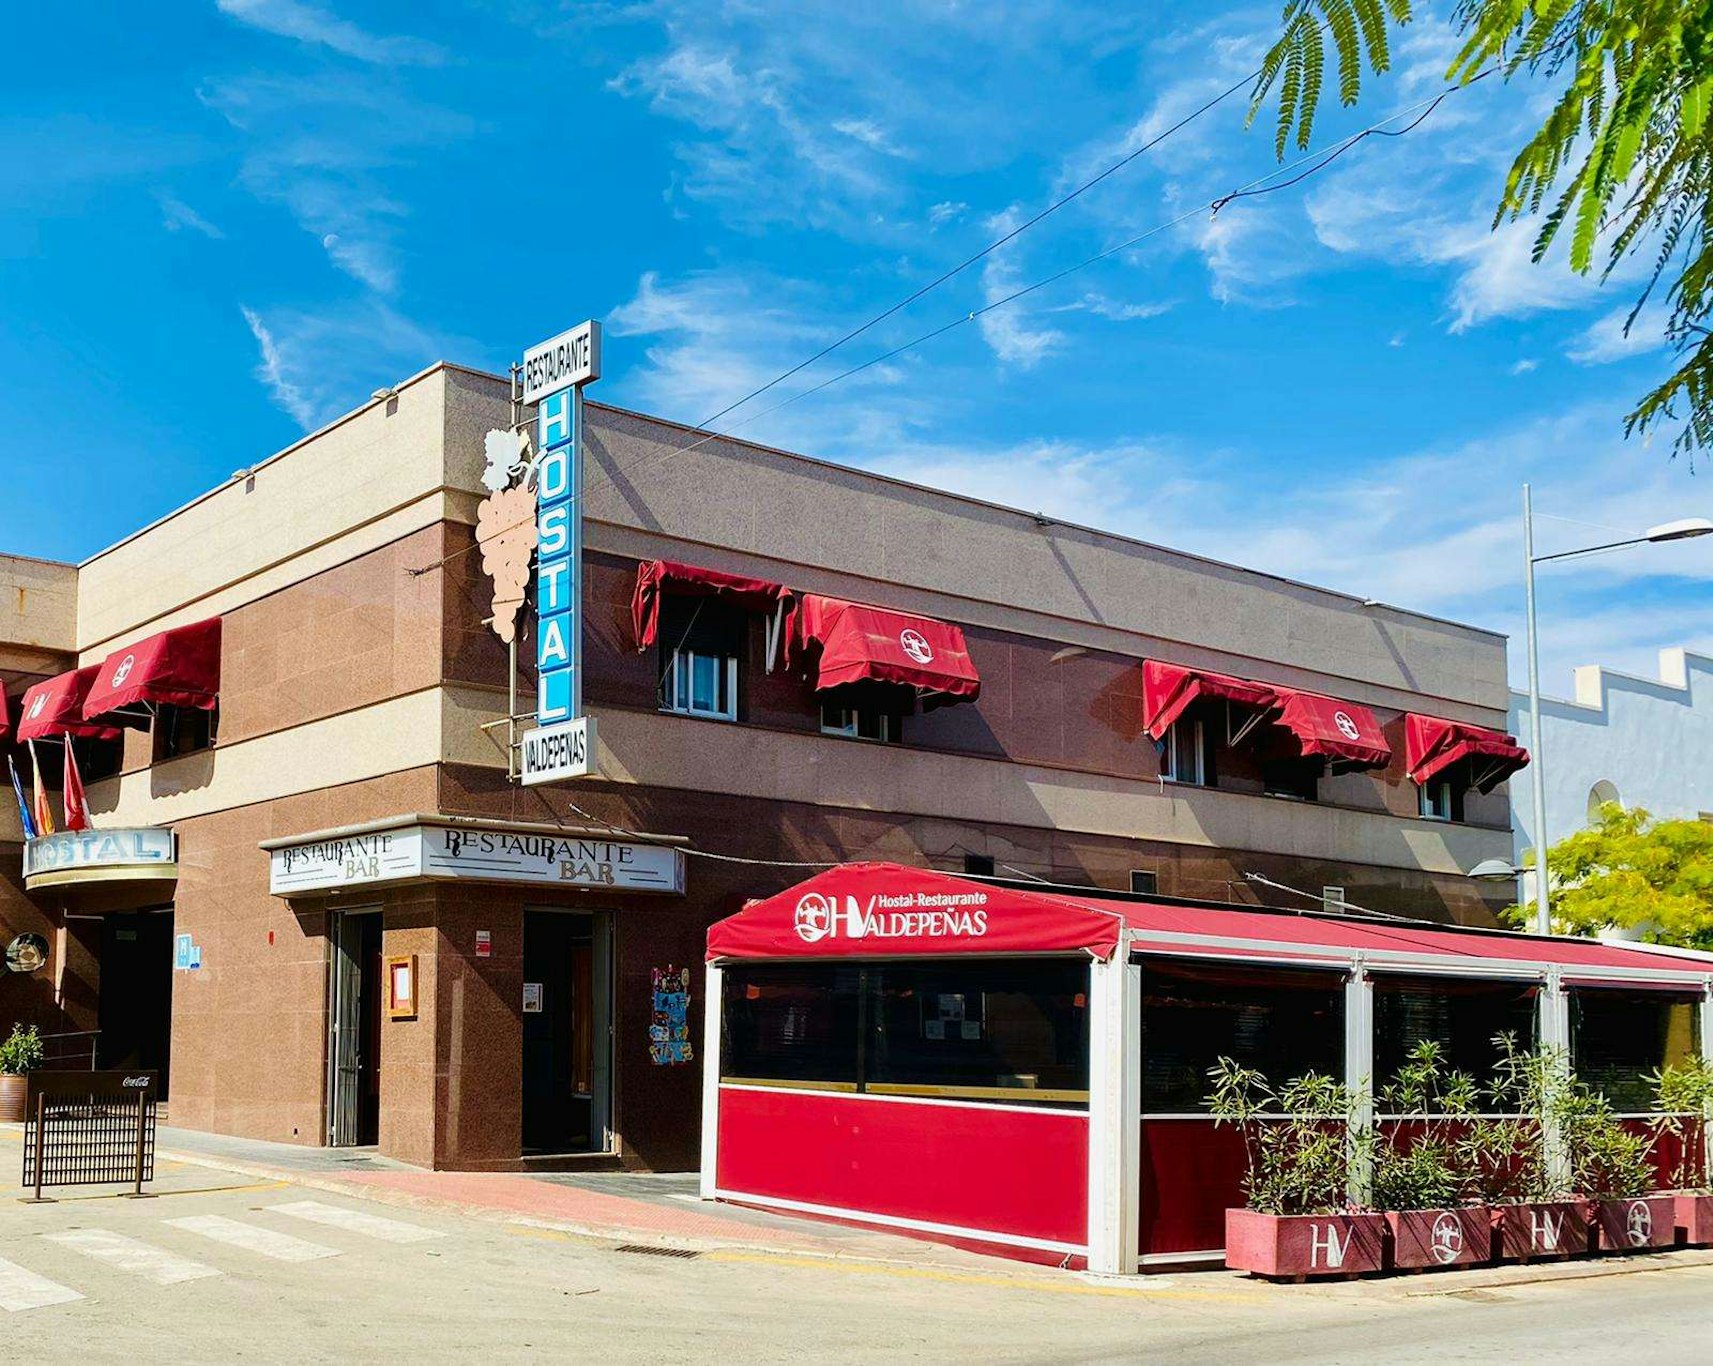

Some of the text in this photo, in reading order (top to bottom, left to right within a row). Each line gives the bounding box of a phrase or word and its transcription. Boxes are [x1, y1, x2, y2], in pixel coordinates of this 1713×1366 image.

[526, 333, 589, 393] RESTAURANTE
[540, 392, 568, 720] HOSTAL
[32, 830, 162, 869] HOSTAL
[283, 834, 393, 873] RESTAURANTE
[445, 829, 634, 865] RESTAURANTE
[345, 856, 380, 880] BAR
[559, 860, 615, 885] BAR
[878, 891, 988, 908] Hostal-Restaurante
[1310, 1223, 1353, 1268] HV
[1530, 1210, 1564, 1251] HV
